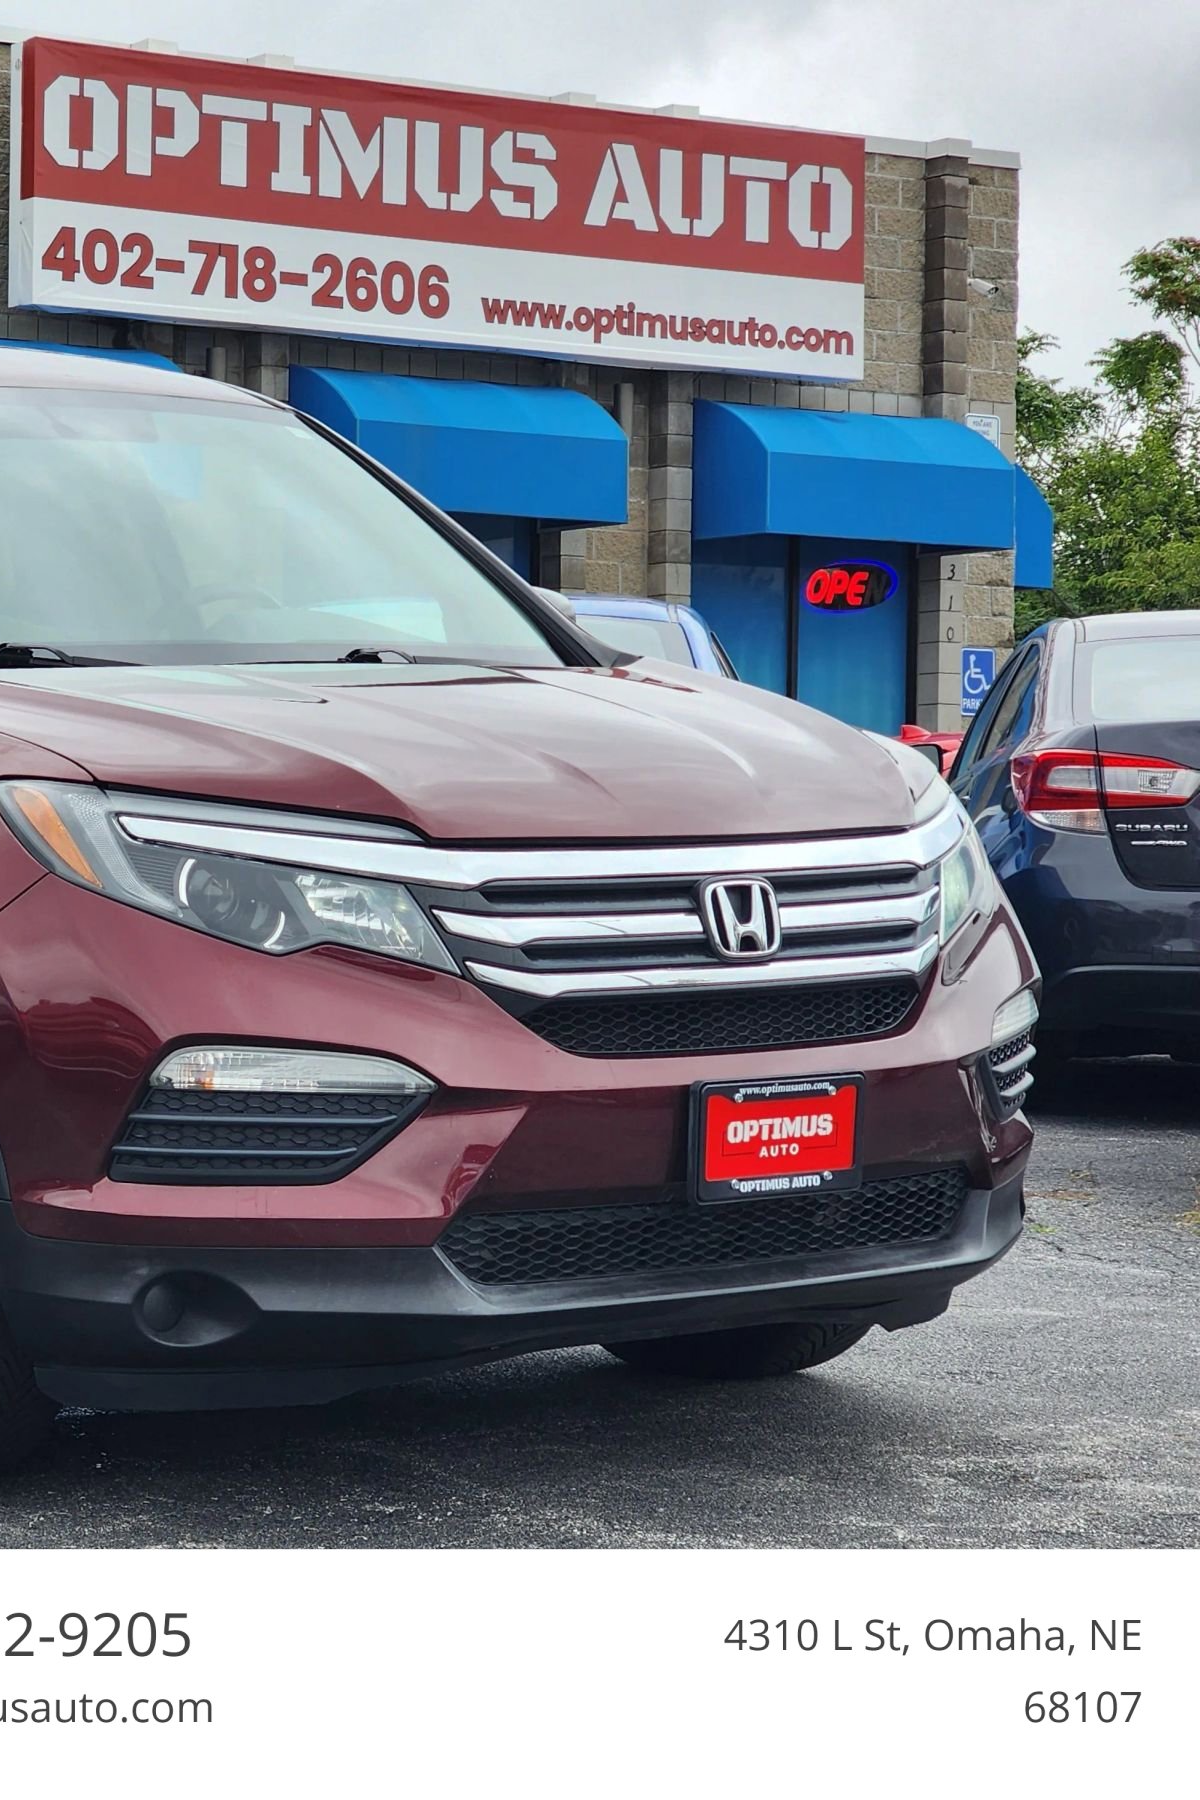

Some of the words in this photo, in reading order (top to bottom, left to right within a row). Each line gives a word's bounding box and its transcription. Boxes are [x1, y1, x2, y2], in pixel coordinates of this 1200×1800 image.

[43, 75, 558, 220] OPTIMUS
[583, 142, 853, 251] AUTO
[41, 226, 450, 319] 402-718-2606
[481, 297, 854, 356] www.optimusauto.com
[962, 697, 983, 710] PARK
[1115, 823, 1189, 832] SUBARU
[738, 1081, 831, 1097] www.optimusauto.com
[727, 1113, 833, 1144] OPTIMUS
[759, 1143, 800, 1158] AUTO
[740, 1177, 791, 1193] OPTIMUS
[792, 1174, 821, 1189] AUTO
